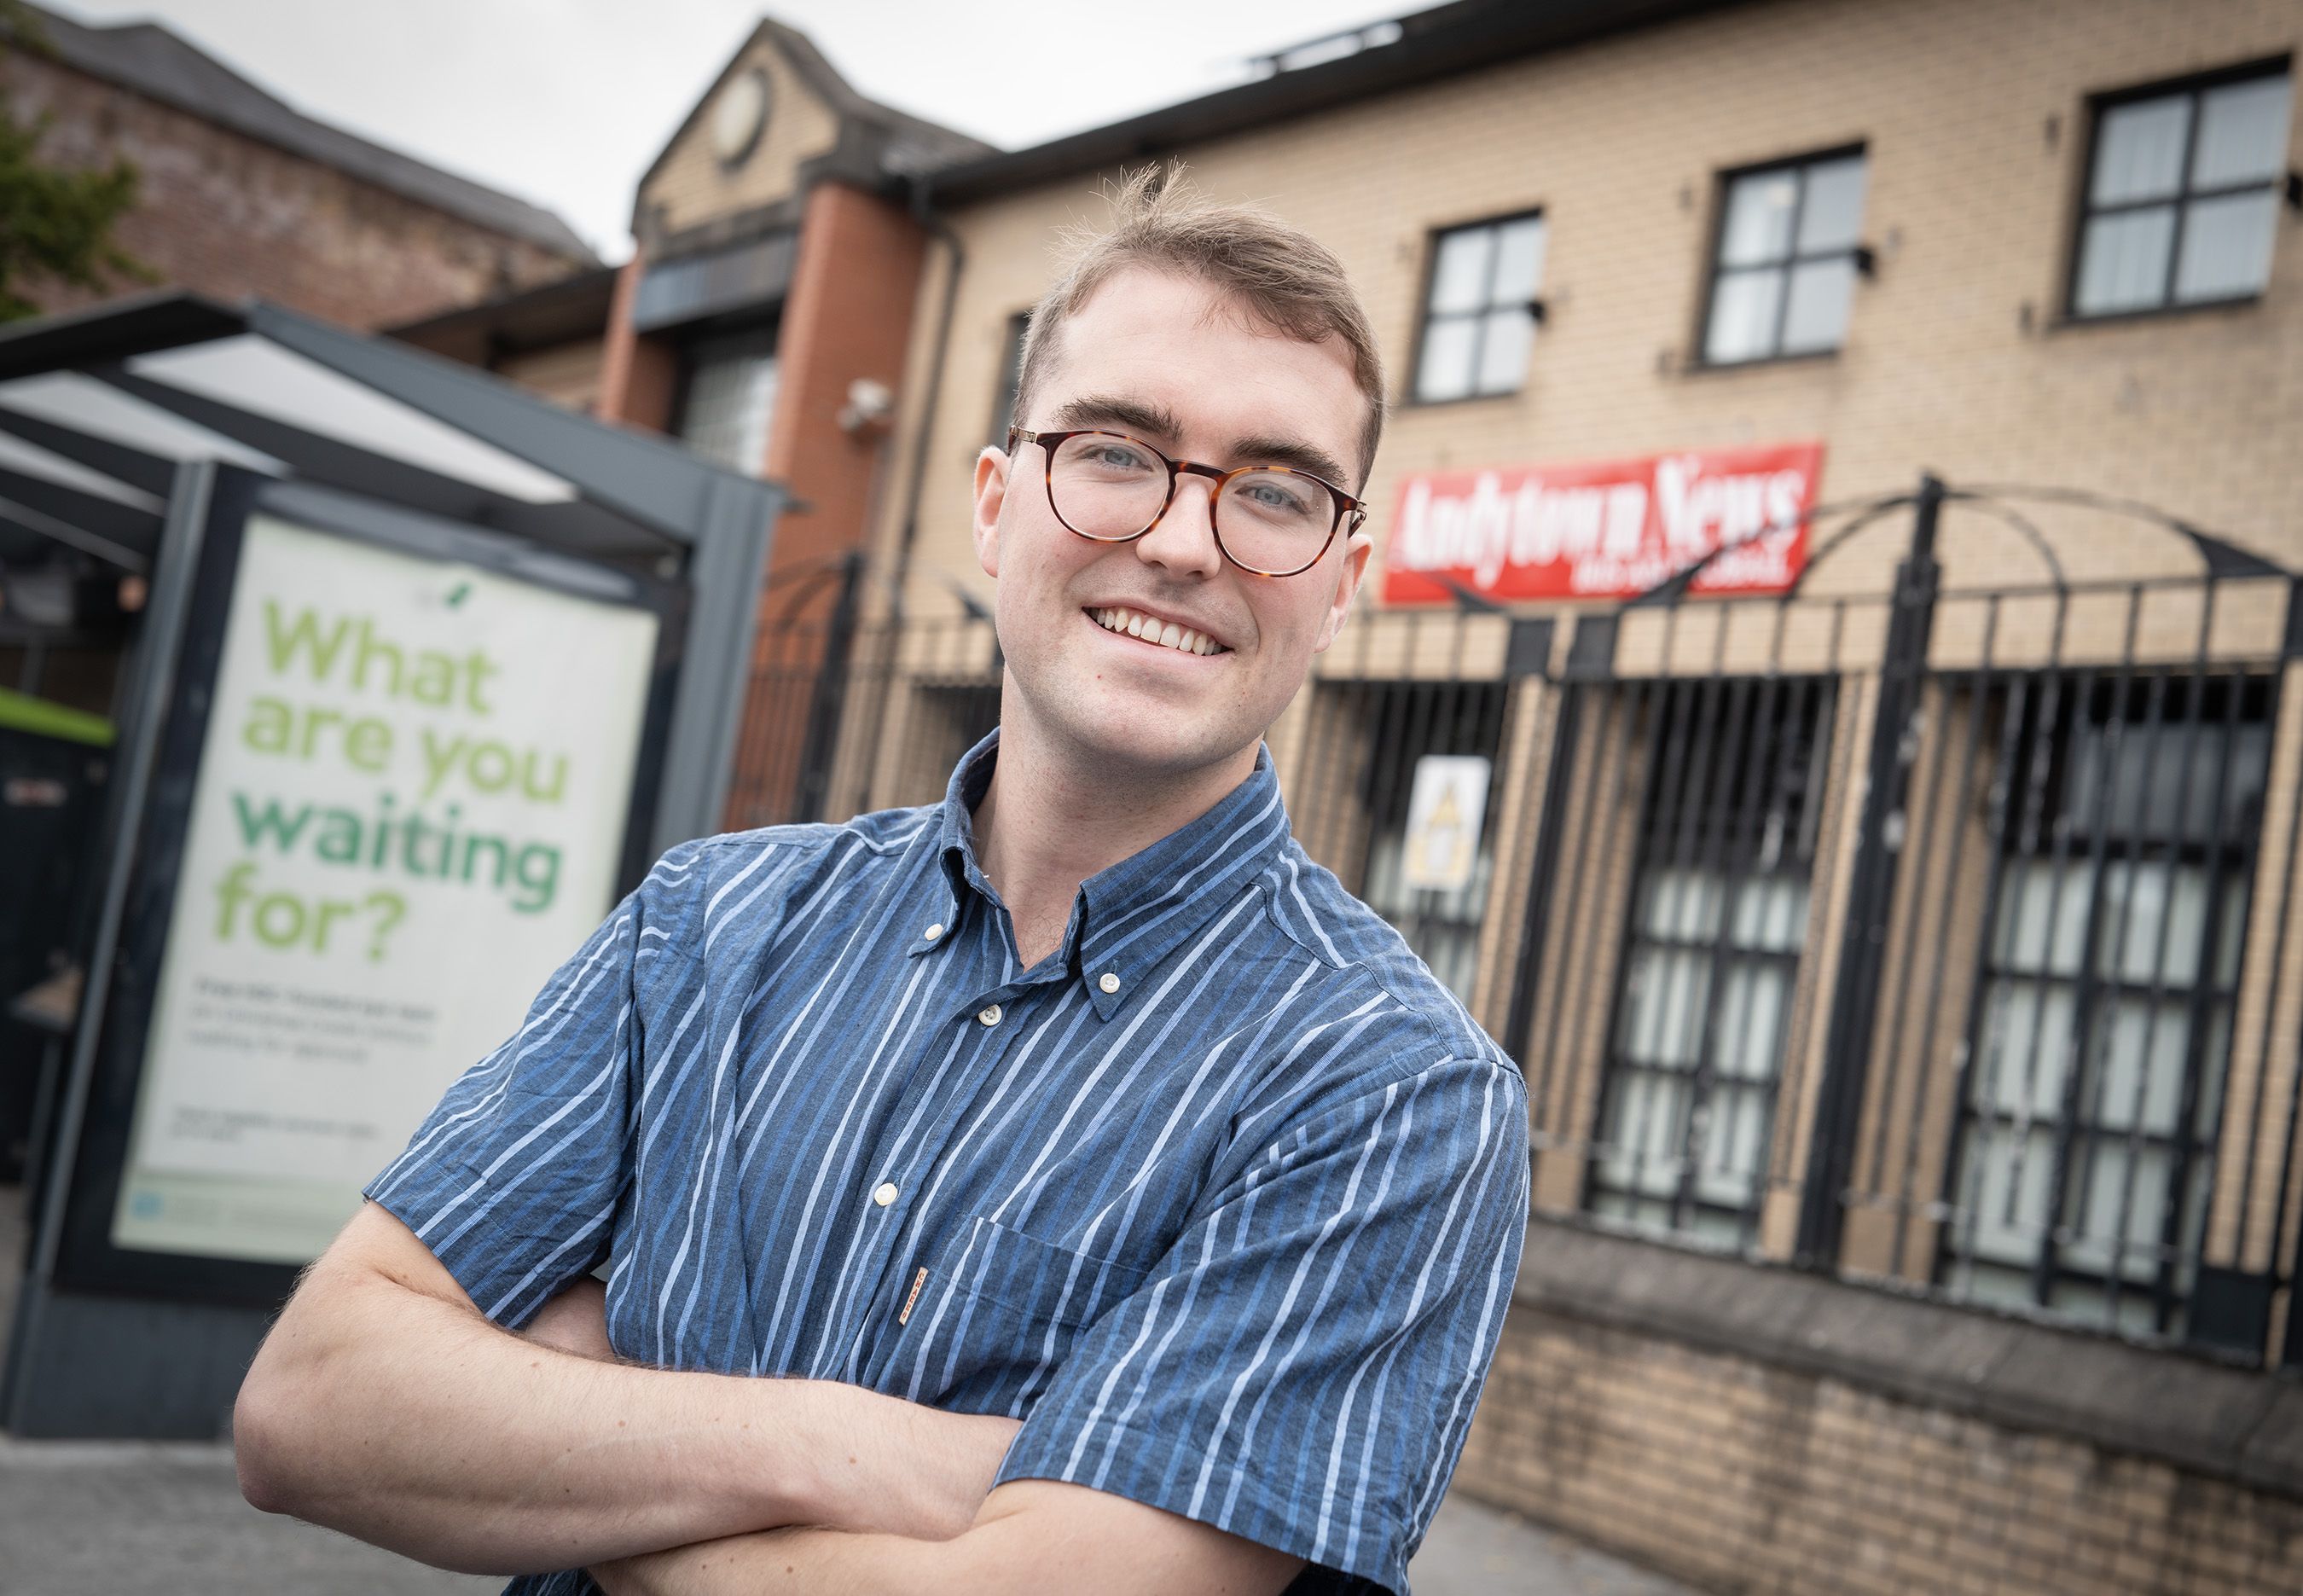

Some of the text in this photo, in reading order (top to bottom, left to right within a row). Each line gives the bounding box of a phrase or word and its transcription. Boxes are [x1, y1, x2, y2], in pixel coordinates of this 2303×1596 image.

[1399, 472, 1648, 589] Andytown
[1656, 454, 1807, 553] News
[260, 601, 499, 715] What
[241, 694, 571, 804] are you
[231, 792, 564, 914] waiting
[213, 862, 406, 962] for?
